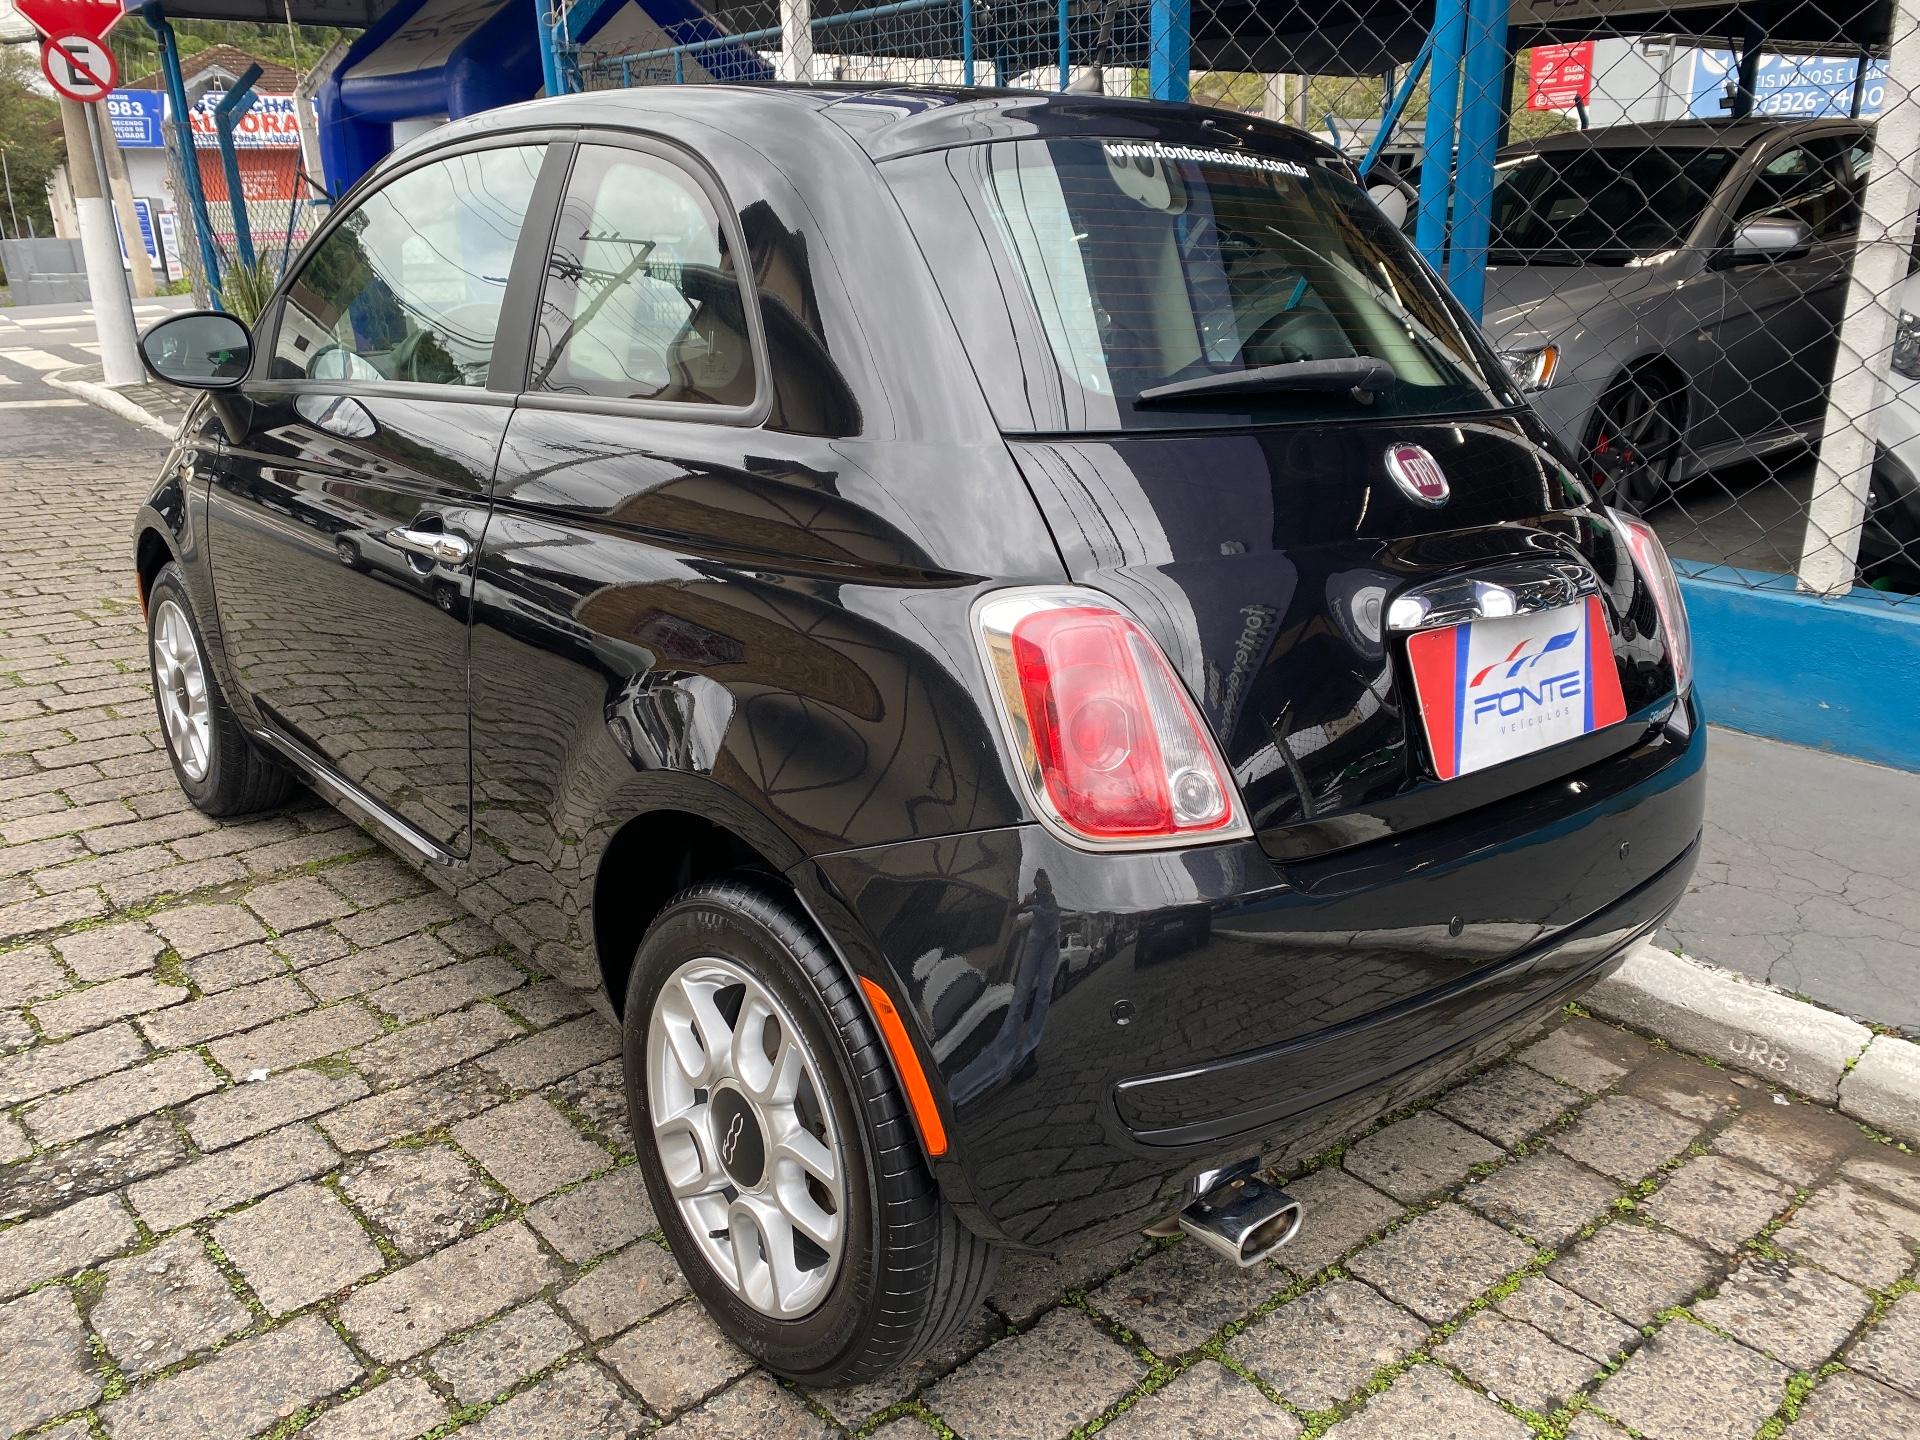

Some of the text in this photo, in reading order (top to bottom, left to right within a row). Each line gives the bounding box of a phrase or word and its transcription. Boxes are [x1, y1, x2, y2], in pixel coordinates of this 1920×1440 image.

[63, 45, 97, 85] E
[1779, 68, 1833, 87] NOVOS
[1836, 68, 1846, 82] E
[1104, 142, 1310, 178] www.fonteveiculos.com.br
[1402, 458, 1441, 487] FIAT
[1474, 670, 1582, 725] FONTE
